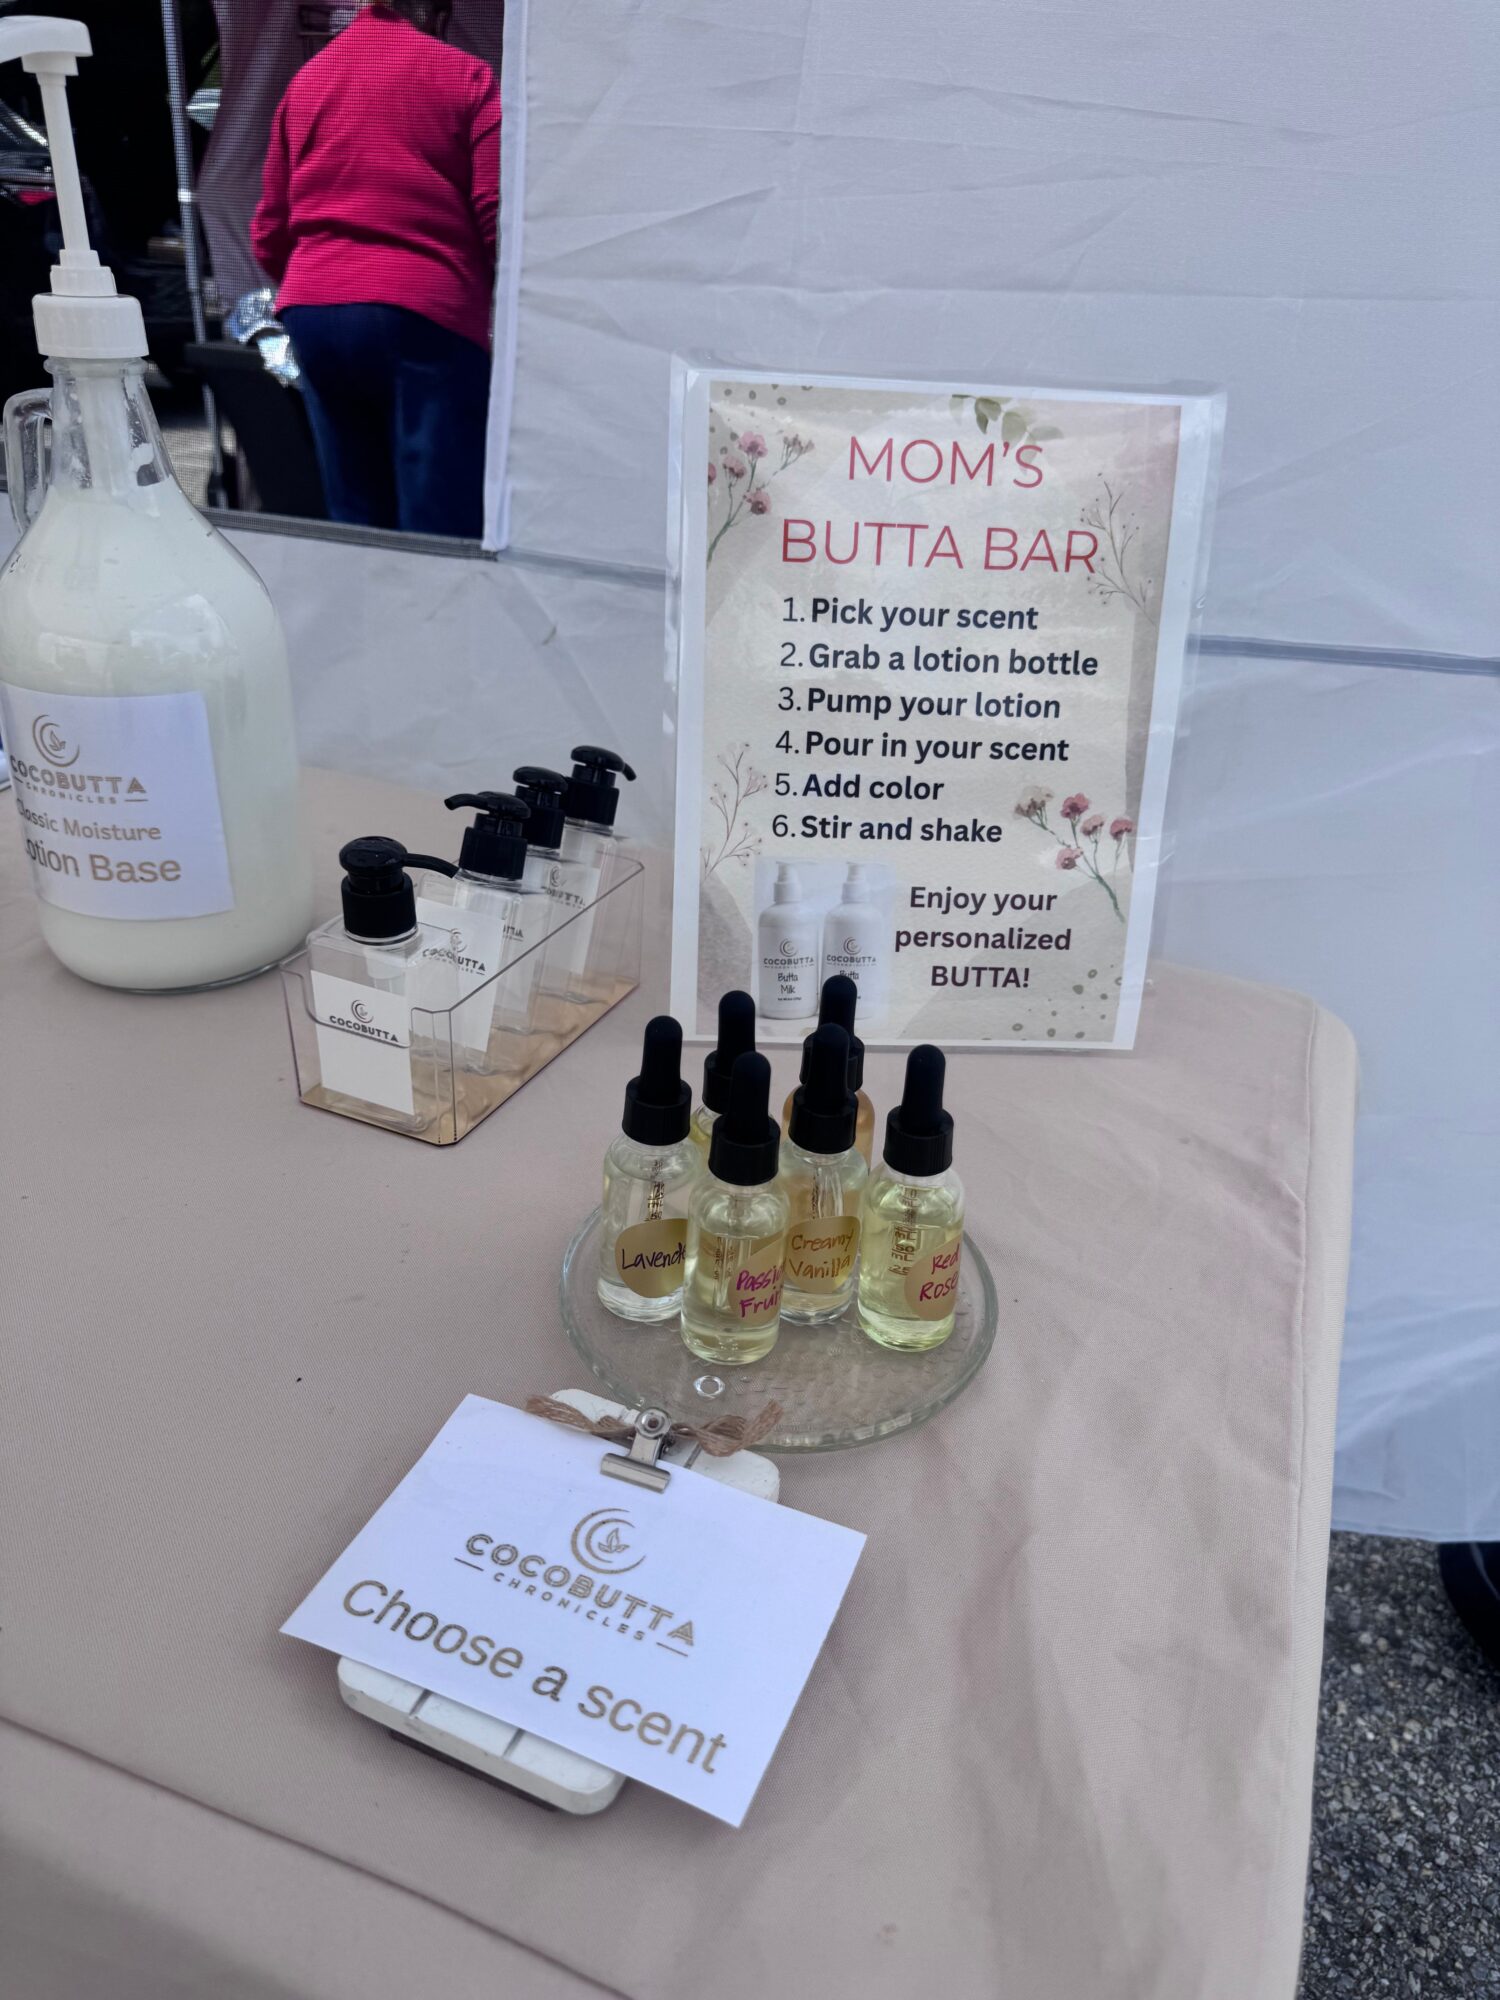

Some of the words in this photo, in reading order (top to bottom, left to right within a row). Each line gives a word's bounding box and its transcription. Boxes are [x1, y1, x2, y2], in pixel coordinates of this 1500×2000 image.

[848, 435, 1043, 489] MOM'S
[781, 518, 964, 570] BUTTA
[983, 527, 1099, 574] BAR
[782, 596, 805, 623] 1.
[811, 596, 873, 625] Pick
[879, 606, 951, 633] your
[956, 607, 1039, 631] scent
[780, 641, 804, 668] 2.
[809, 642, 881, 670] Grab
[888, 651, 906, 671] a
[913, 645, 1000, 674] lotion
[1008, 648, 1099, 676] bottle
[777, 686, 802, 712] 3.
[807, 687, 892, 721] Pump
[898, 696, 968, 722] your
[975, 691, 1061, 719] lotion
[775, 730, 800, 754] 4.
[805, 730, 874, 757] Pour
[881, 731, 907, 758] in
[914, 739, 983, 765] your
[989, 739, 1070, 762] scent
[774, 772, 798, 797] 5.
[801, 773, 861, 799] Add
[869, 775, 945, 801] color
[63, 817, 162, 841] Moisture
[772, 814, 796, 838] 6.
[800, 814, 853, 839] Stir
[859, 816, 913, 841] and
[920, 817, 1003, 843] shake
[88, 853, 182, 884] Base
[910, 886, 987, 916] Enjoy
[991, 893, 1058, 917] your
[894, 927, 1072, 953] personalized
[763, 956, 815, 967] COCOBUTTA
[826, 954, 877, 964] COCOBUTTA
[931, 965, 1030, 989] BUTTA!
[329, 1015, 399, 1043] COCOBUTTA
[791, 1229, 855, 1253] Creamy
[789, 1255, 851, 1280] Vanilla
[931, 1243, 961, 1275] Red
[919, 1271, 960, 1302] Rose
[466, 1533, 695, 1647] COCOBUTTA
[493, 1571, 646, 1642] CHRONICLES
[343, 1579, 524, 1679] Choose
[531, 1665, 569, 1702] a
[577, 1684, 727, 1774] scent
